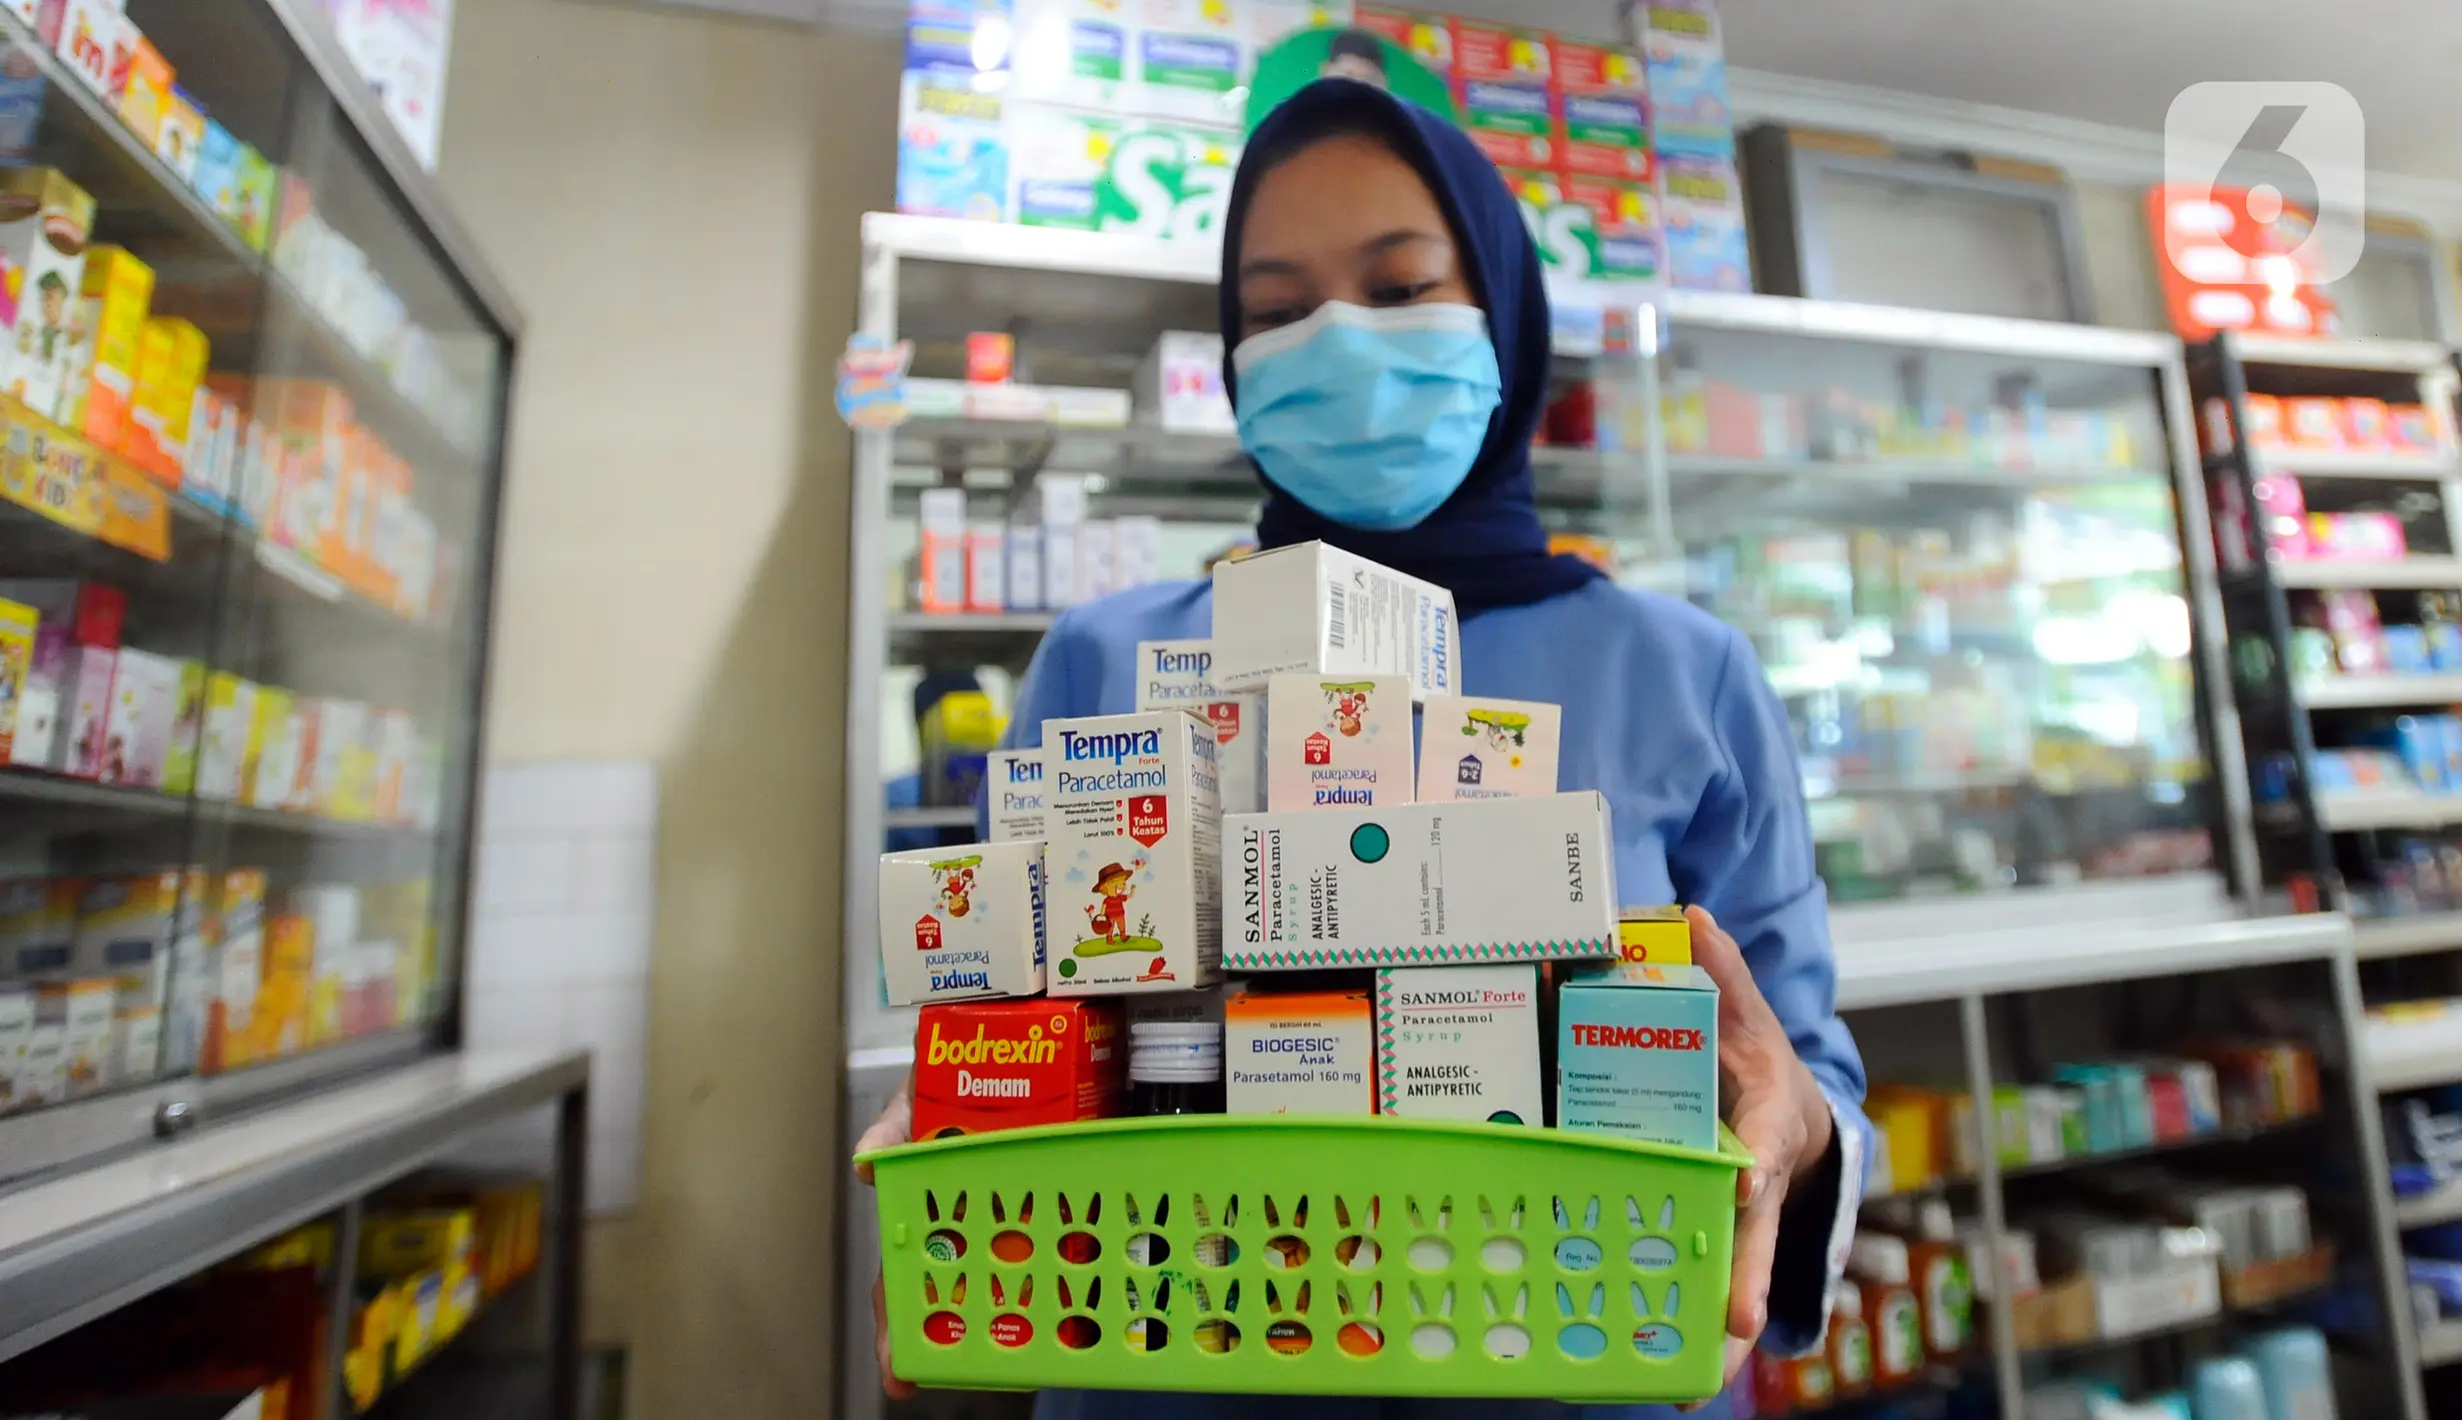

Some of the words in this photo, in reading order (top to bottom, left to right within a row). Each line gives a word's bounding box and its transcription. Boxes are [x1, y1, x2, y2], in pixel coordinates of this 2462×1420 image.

[1434, 606, 1449, 691] Tempra
[1152, 649, 1212, 677] Temp
[1138, 757, 1160, 765] Forte
[1059, 764, 1166, 793] Paracetamol
[1312, 769, 1377, 784] Paracetamol
[1142, 799, 1153, 813] 6
[1132, 816, 1164, 826] Tahun
[1132, 826, 1166, 836] Keatas
[1566, 832, 1583, 903] SANBE
[1243, 829, 1260, 943] SANMOL
[1269, 828, 1283, 942] Paracetamol
[1310, 876, 1323, 940] ANALGESIC
[1325, 865, 1340, 940] ANTIPYRETIC
[1027, 860, 1046, 972] Tempra
[1288, 883, 1299, 942] Syrup
[925, 936, 934, 947] 6
[925, 950, 990, 969] Paracetamol
[931, 970, 992, 992] Tempra
[1401, 990, 1478, 1005] SANMOL
[1482, 990, 1526, 1004] Forte
[1402, 1012, 1494, 1025] Paracetamol
[926, 1023, 1057, 1066] bodrexin
[1402, 1031, 1462, 1044] Syrup
[1252, 1038, 1335, 1053] BIOGESIC
[1299, 1054, 1335, 1065] Anak
[1233, 1069, 1314, 1084] Parasetamol
[1319, 1071, 1339, 1082] 160
[1342, 1072, 1361, 1085] mg
[1407, 1065, 1470, 1079] ANALGESIC
[1568, 1071, 1612, 1081] Komposisi
[957, 1069, 1031, 1098] Demam
[1407, 1083, 1483, 1097] ANTIPYRETIC
[1673, 1103, 1688, 1112] 160
[1568, 1118, 1595, 1127] Aturan
